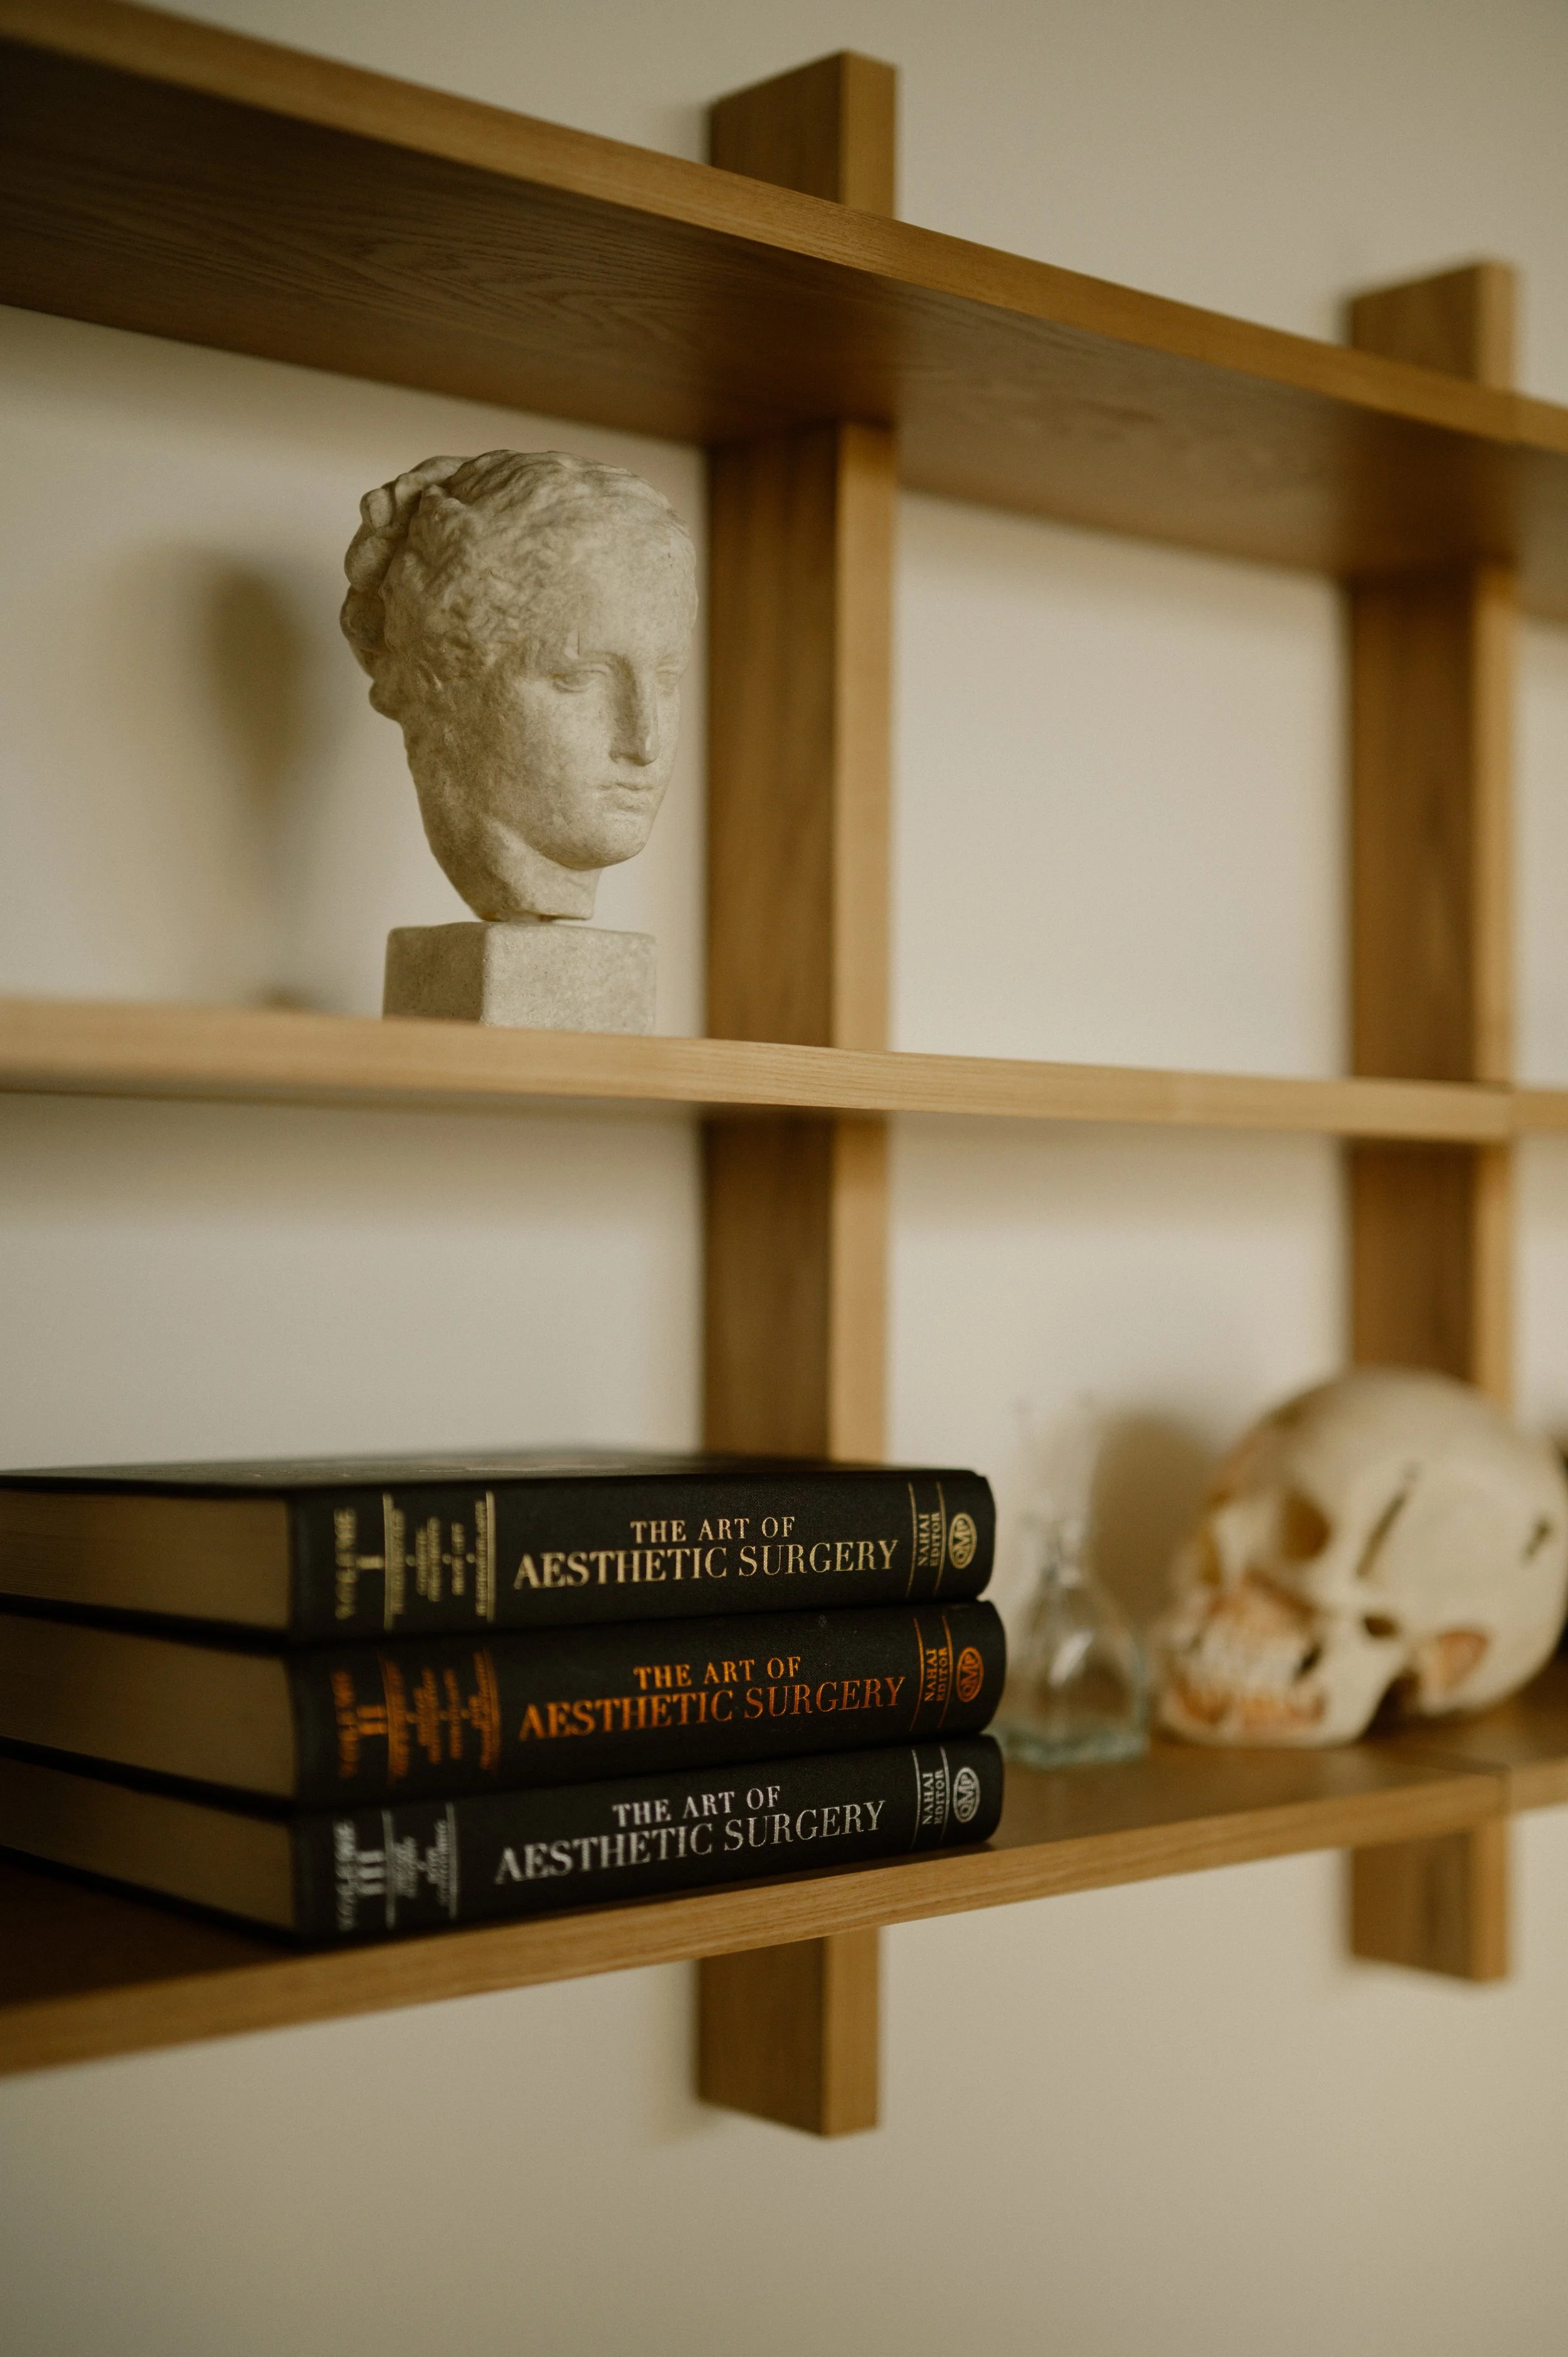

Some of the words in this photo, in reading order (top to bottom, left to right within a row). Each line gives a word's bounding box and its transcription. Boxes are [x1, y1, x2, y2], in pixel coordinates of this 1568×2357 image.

[630, 1520, 687, 1544] THE
[699, 1518, 749, 1540] ART
[762, 1517, 795, 1538] OF
[918, 1514, 930, 1567] NAHAI
[930, 1511, 941, 1567] EDITOR
[514, 1547, 726, 1589] AESTHETIC
[739, 1540, 898, 1576] SURGERY
[633, 1664, 692, 1690] THE
[704, 1659, 755, 1684] ART
[767, 1656, 800, 1678] OF
[924, 1648, 938, 1701] NAHAI
[936, 1646, 948, 1701] EDITOR
[519, 1690, 733, 1740] AESTHETIC
[744, 1676, 905, 1718] SURGERY
[612, 1799, 671, 1828] THE
[684, 1792, 734, 1817] ART
[747, 1786, 780, 1809] OF
[922, 1772, 934, 1825] NAHAI
[934, 1769, 945, 1825] EDITOR
[494, 1823, 712, 1884] AESTHETIC
[724, 1801, 885, 1850] SURGERY
